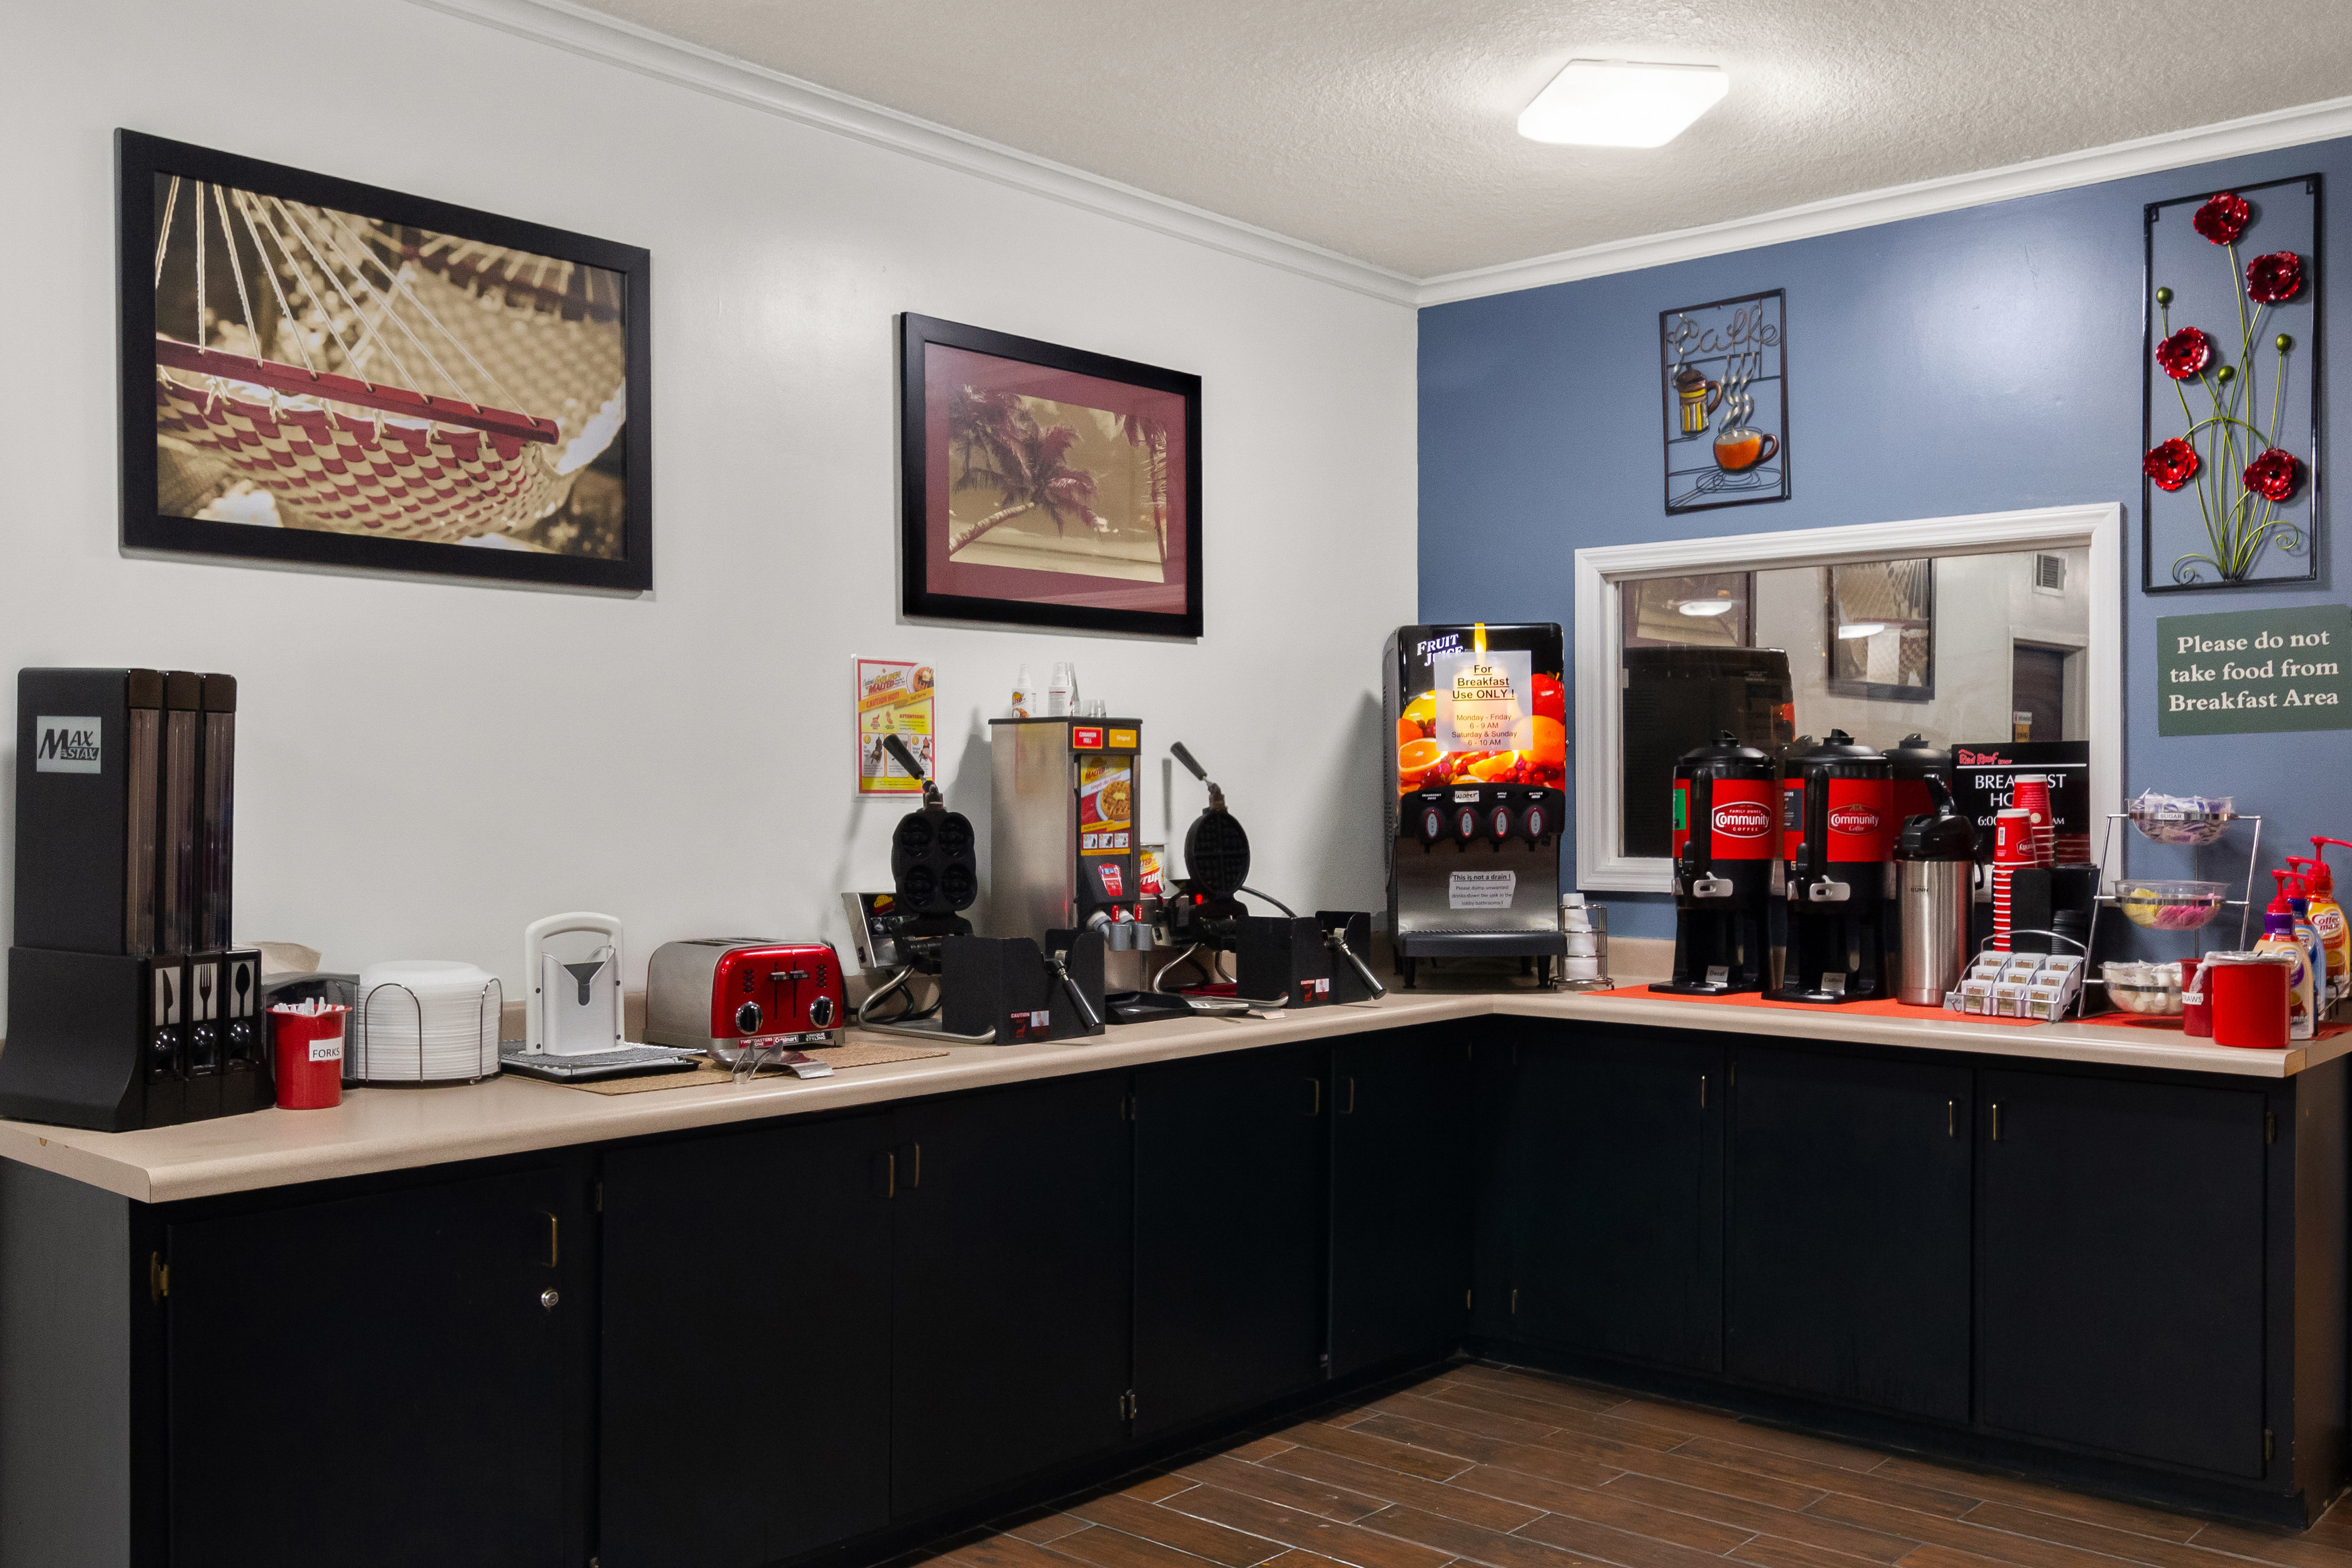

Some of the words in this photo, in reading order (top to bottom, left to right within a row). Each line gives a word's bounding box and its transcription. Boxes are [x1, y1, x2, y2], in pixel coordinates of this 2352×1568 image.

[1417, 633, 1459, 656] FRUIT
[2177, 635, 2248, 654] Please
[2254, 631, 2283, 649] do
[2290, 631, 2330, 647] not
[1474, 665, 1492, 673] For
[2170, 664, 2216, 683] take
[2223, 661, 2274, 680] food
[2281, 659, 2339, 676] from
[869, 680, 895, 694] MALTED
[1458, 677, 1509, 686] Breakfast
[866, 695, 887, 707] CAUTION
[1453, 690, 1473, 699] Use
[1477, 690, 1507, 698] ONLY
[2169, 691, 2278, 712] Breakfast
[2283, 689, 2339, 706] Area
[38, 729, 93, 760] MAX
[1959, 752, 1976, 764] Red
[1977, 752, 1999, 765] Roof
[1975, 774, 2067, 789] BREAST
[1715, 812, 1769, 828] Community
[1831, 813, 1879, 827] Community
[2312, 914, 2340, 926] Coffee
[313, 1047, 340, 1058] FORKS
